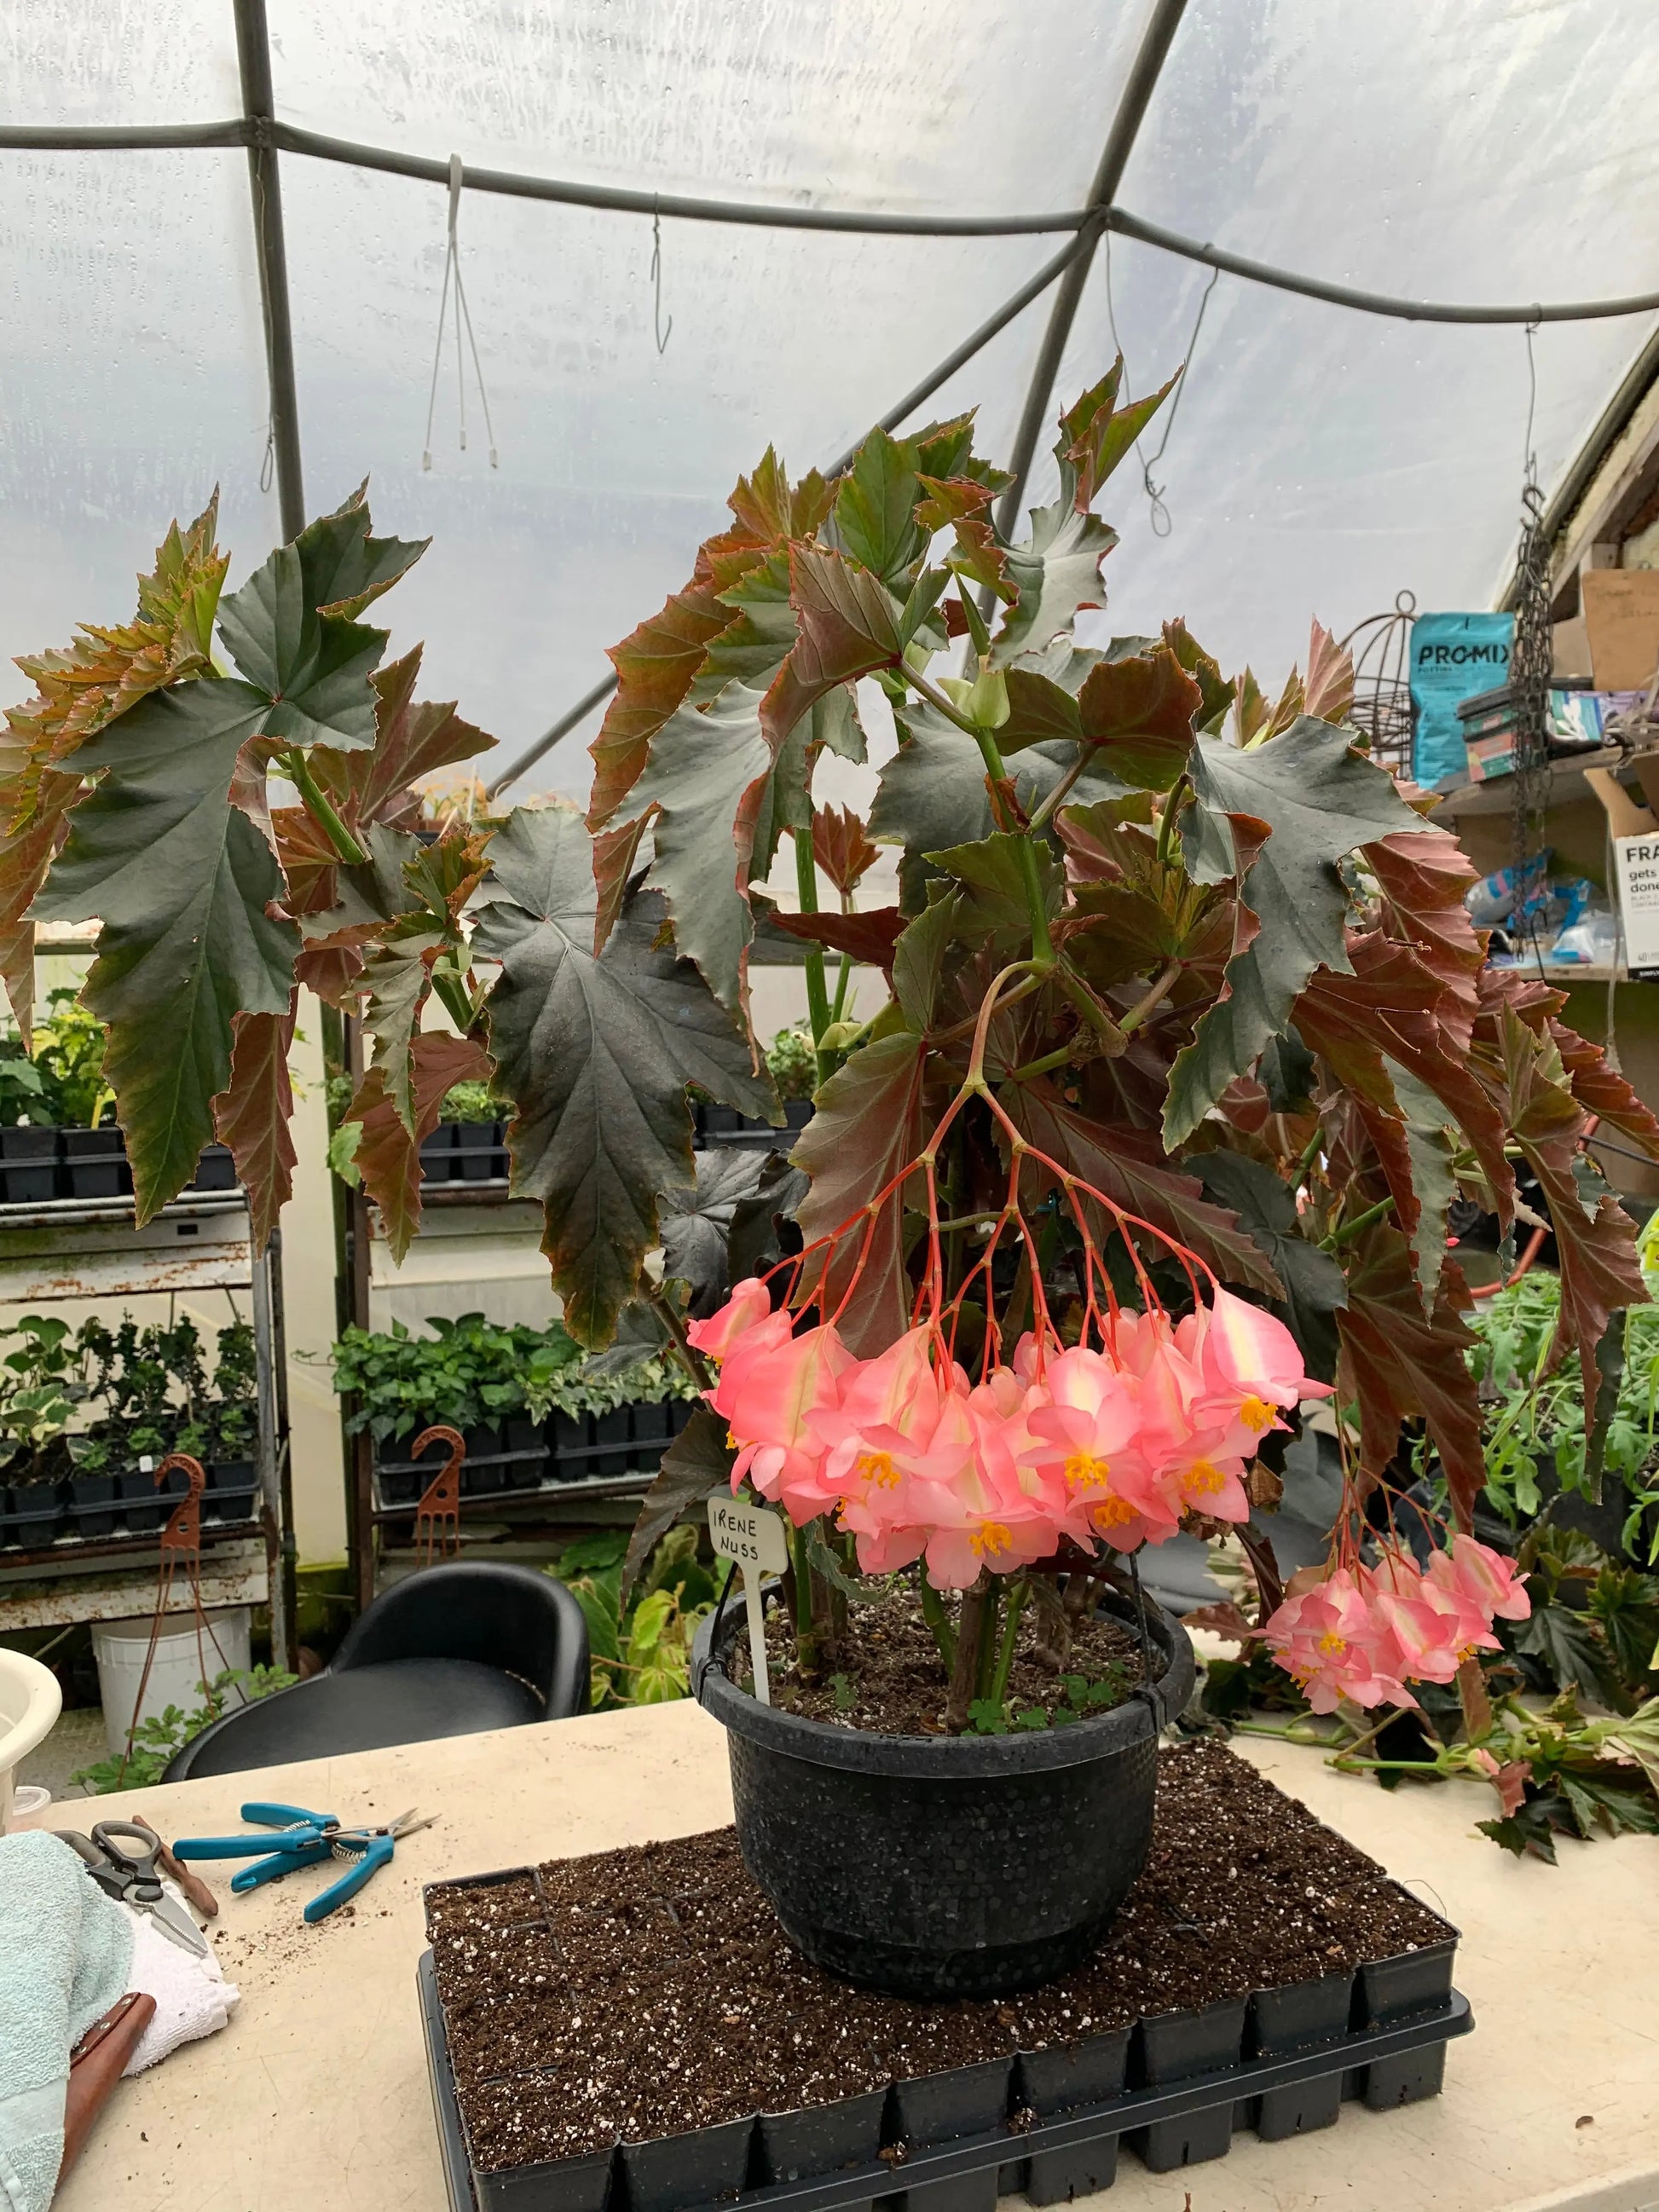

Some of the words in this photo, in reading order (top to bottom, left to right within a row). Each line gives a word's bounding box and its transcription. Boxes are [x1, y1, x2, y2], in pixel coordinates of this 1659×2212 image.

[1628, 869, 1656, 881] gets
[714, 1508, 757, 1537] IRENE
[720, 1536, 758, 1560] NUSS
